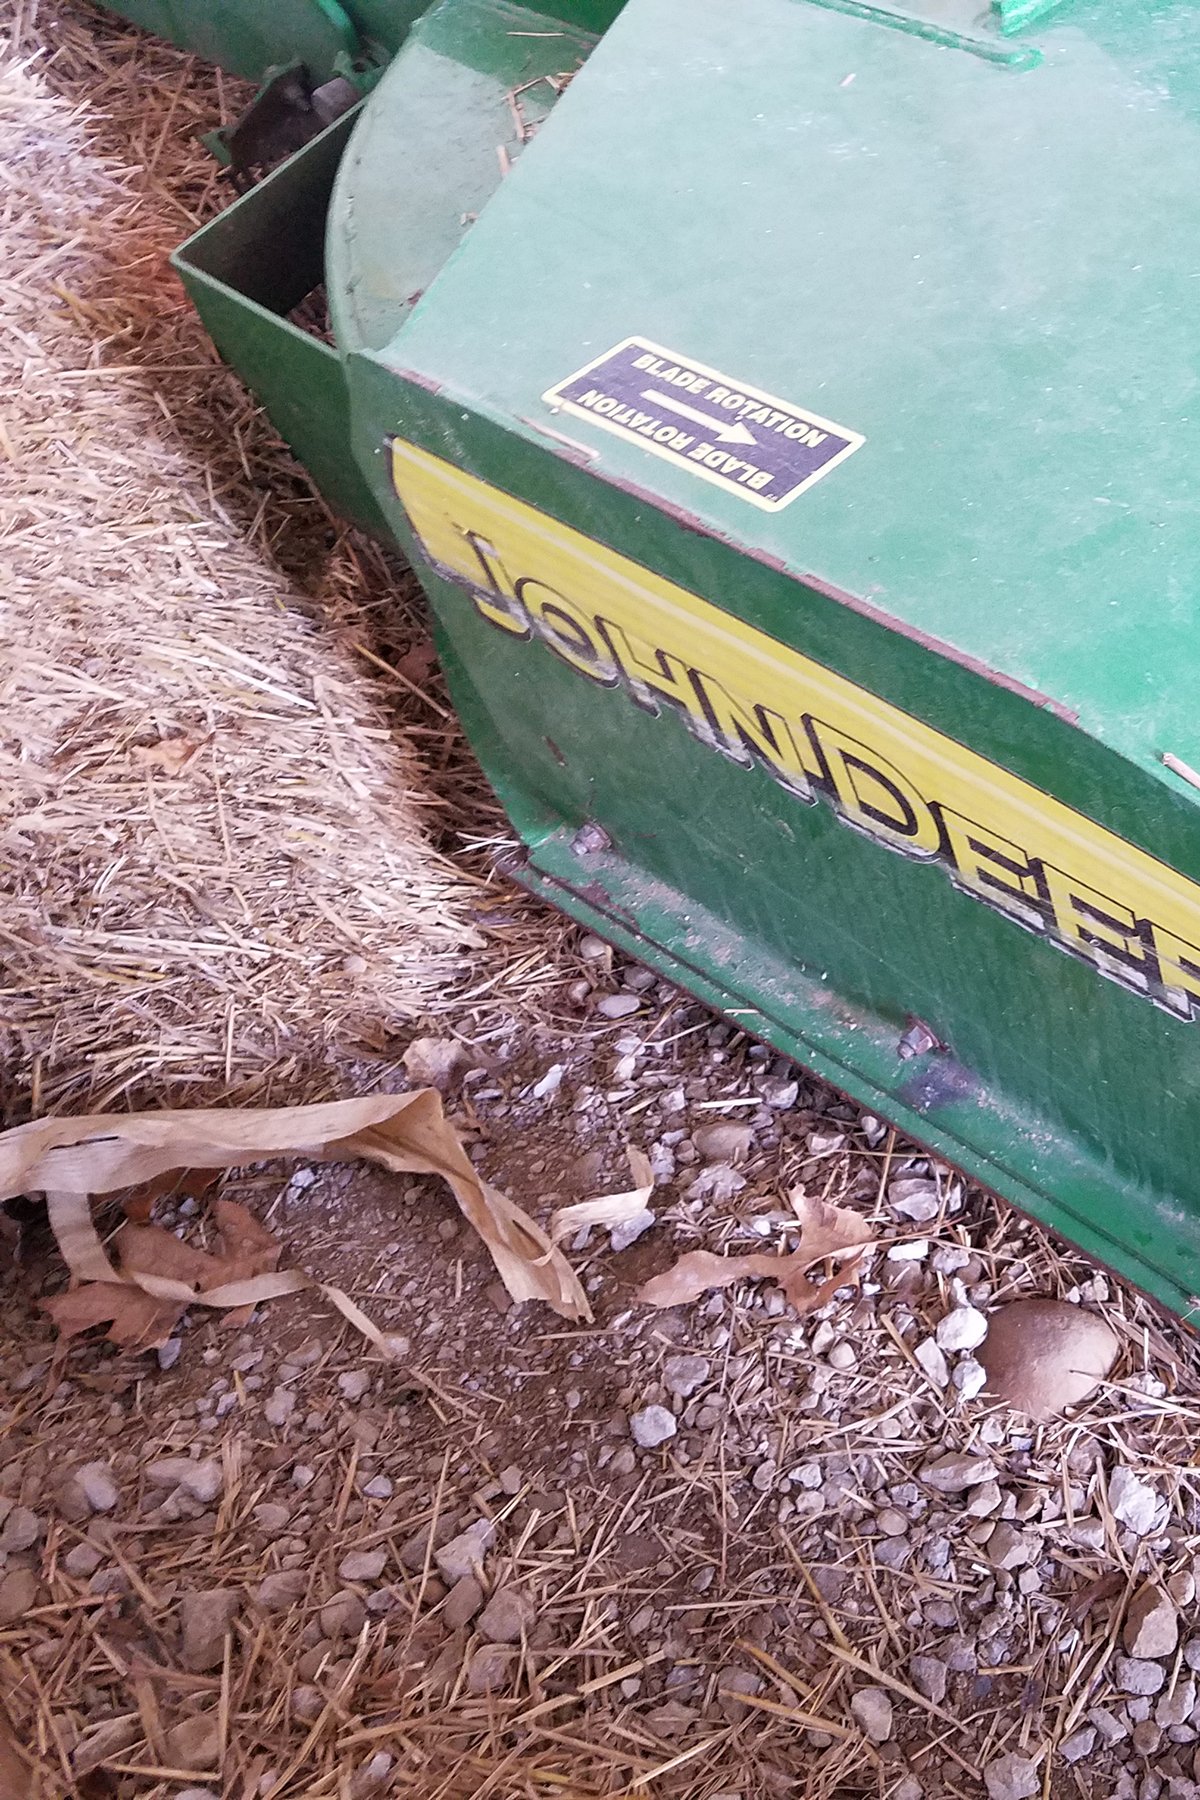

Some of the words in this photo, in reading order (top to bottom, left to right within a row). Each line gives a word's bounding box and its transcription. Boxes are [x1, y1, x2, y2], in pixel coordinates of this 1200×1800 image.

[577, 389, 697, 450] ROTATION
[631, 353, 711, 394] BLADE
[704, 390, 829, 449] ROTATION
[688, 441, 777, 490] BLADE
[463, 527, 819, 807] JOHN
